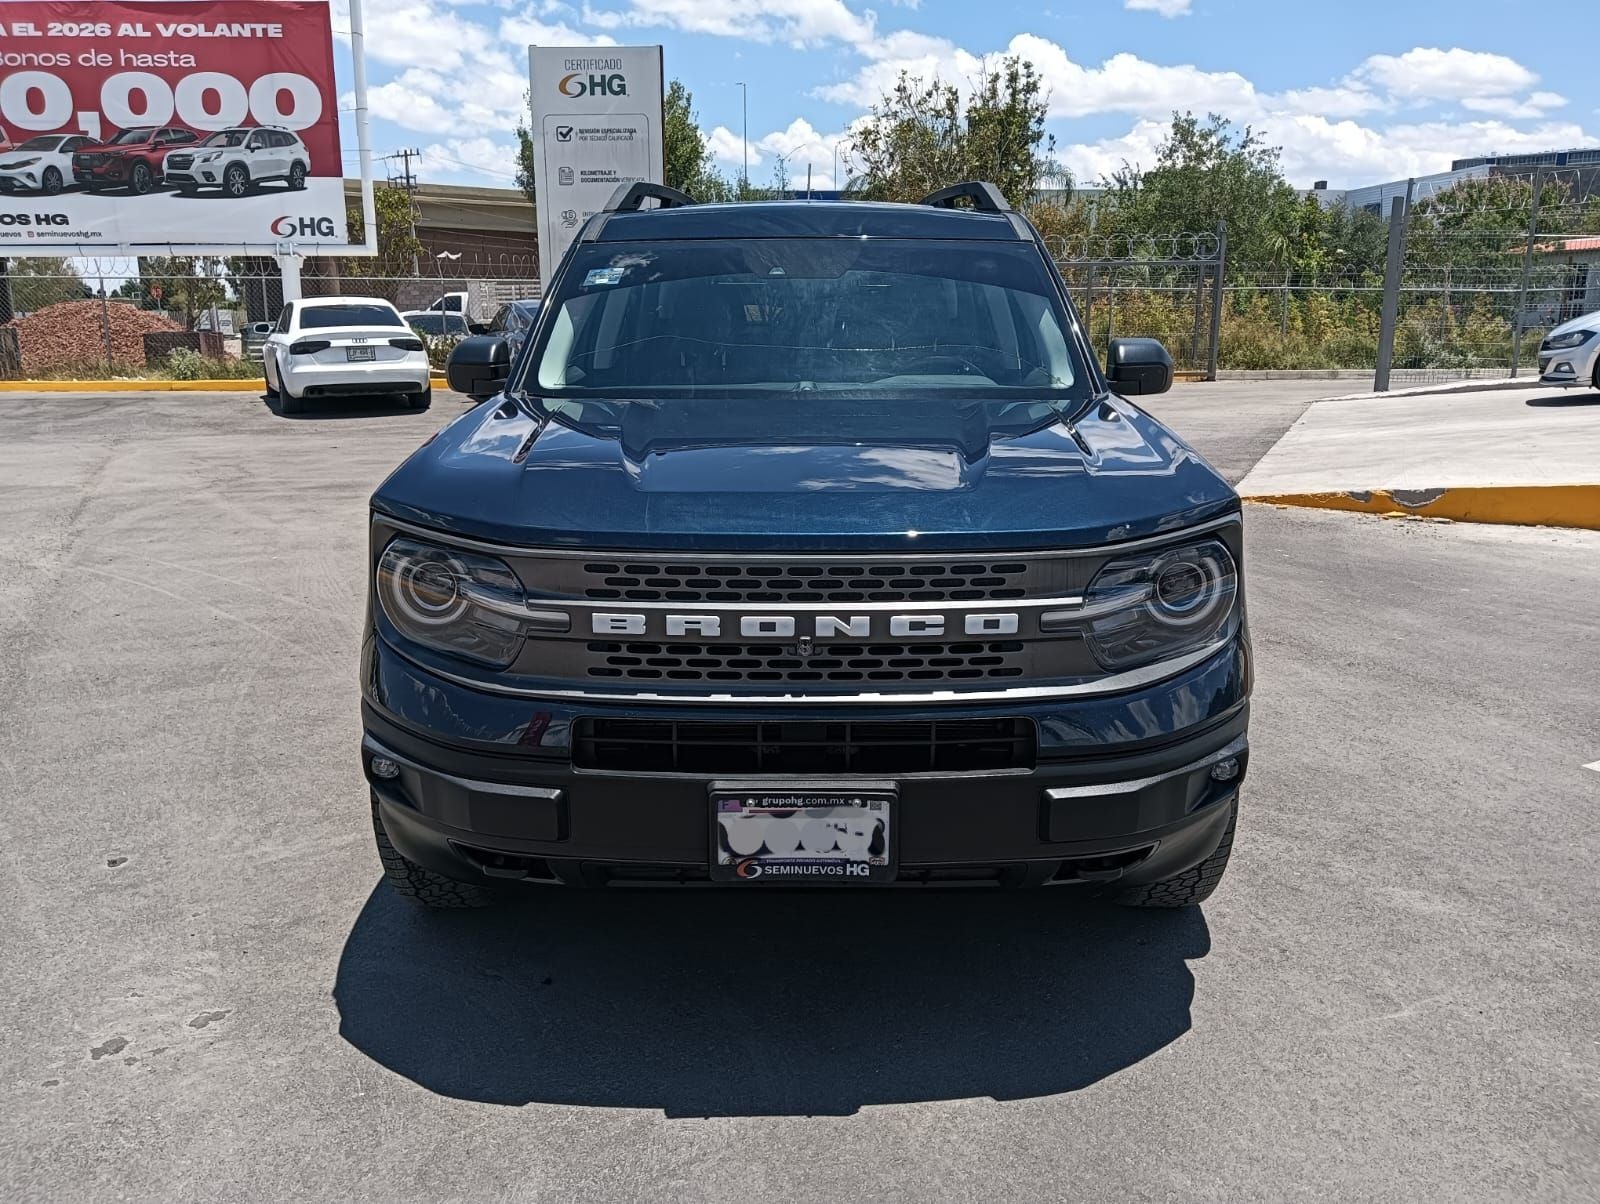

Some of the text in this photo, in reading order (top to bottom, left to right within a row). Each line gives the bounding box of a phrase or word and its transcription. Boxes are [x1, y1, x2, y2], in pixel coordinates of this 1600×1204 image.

[12, 22, 43, 37] EL
[47, 22, 112, 37] 2026
[118, 23, 152, 37] AL
[156, 23, 283, 38] VOLANTE
[0, 49, 196, 68] onos de hasta
[564, 59, 623, 71] CERTIFICADO
[589, 74, 627, 96] HG
[34, 213, 70, 226] HG
[298, 216, 335, 237] HG
[592, 612, 1020, 638] BRONCO
[762, 796, 845, 806] grupohg.com.mx
[764, 863, 870, 876] SEMINUEVOS HG
